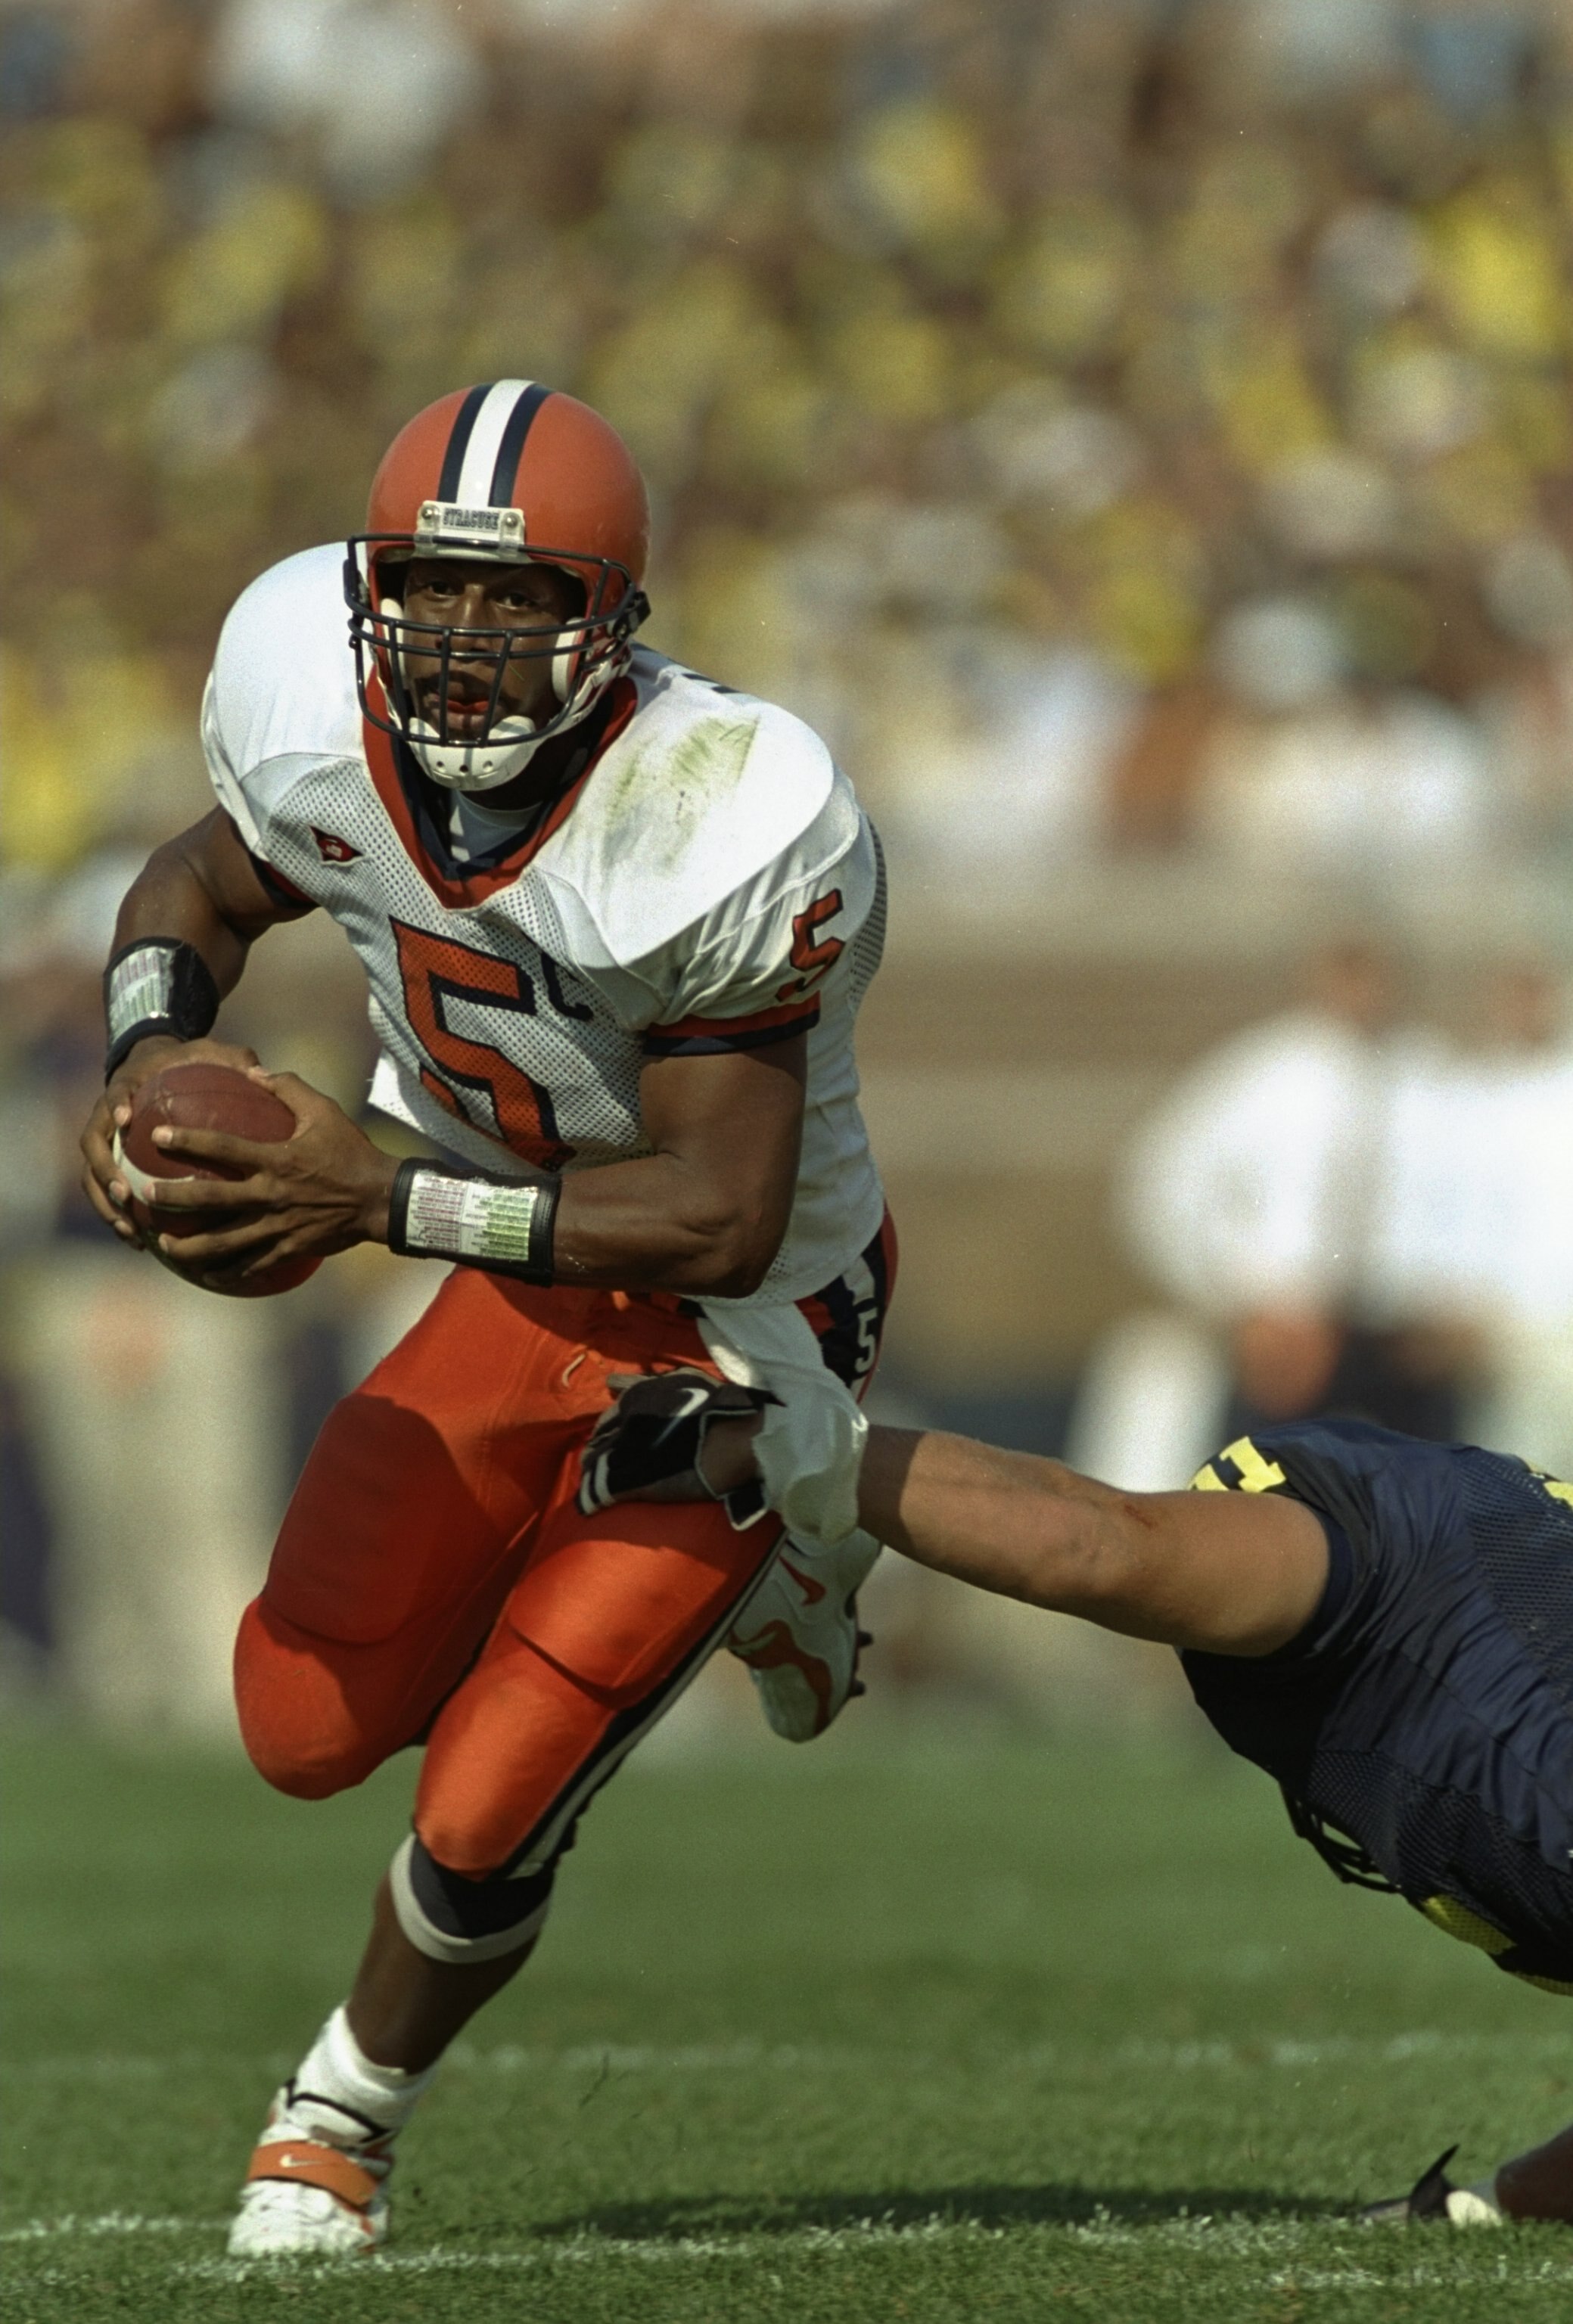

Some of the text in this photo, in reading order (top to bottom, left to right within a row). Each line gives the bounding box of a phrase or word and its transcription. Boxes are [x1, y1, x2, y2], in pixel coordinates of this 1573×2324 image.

[776, 888, 847, 1002] 5
[388, 915, 577, 1172] 5
[855, 1306, 878, 1373] 5
